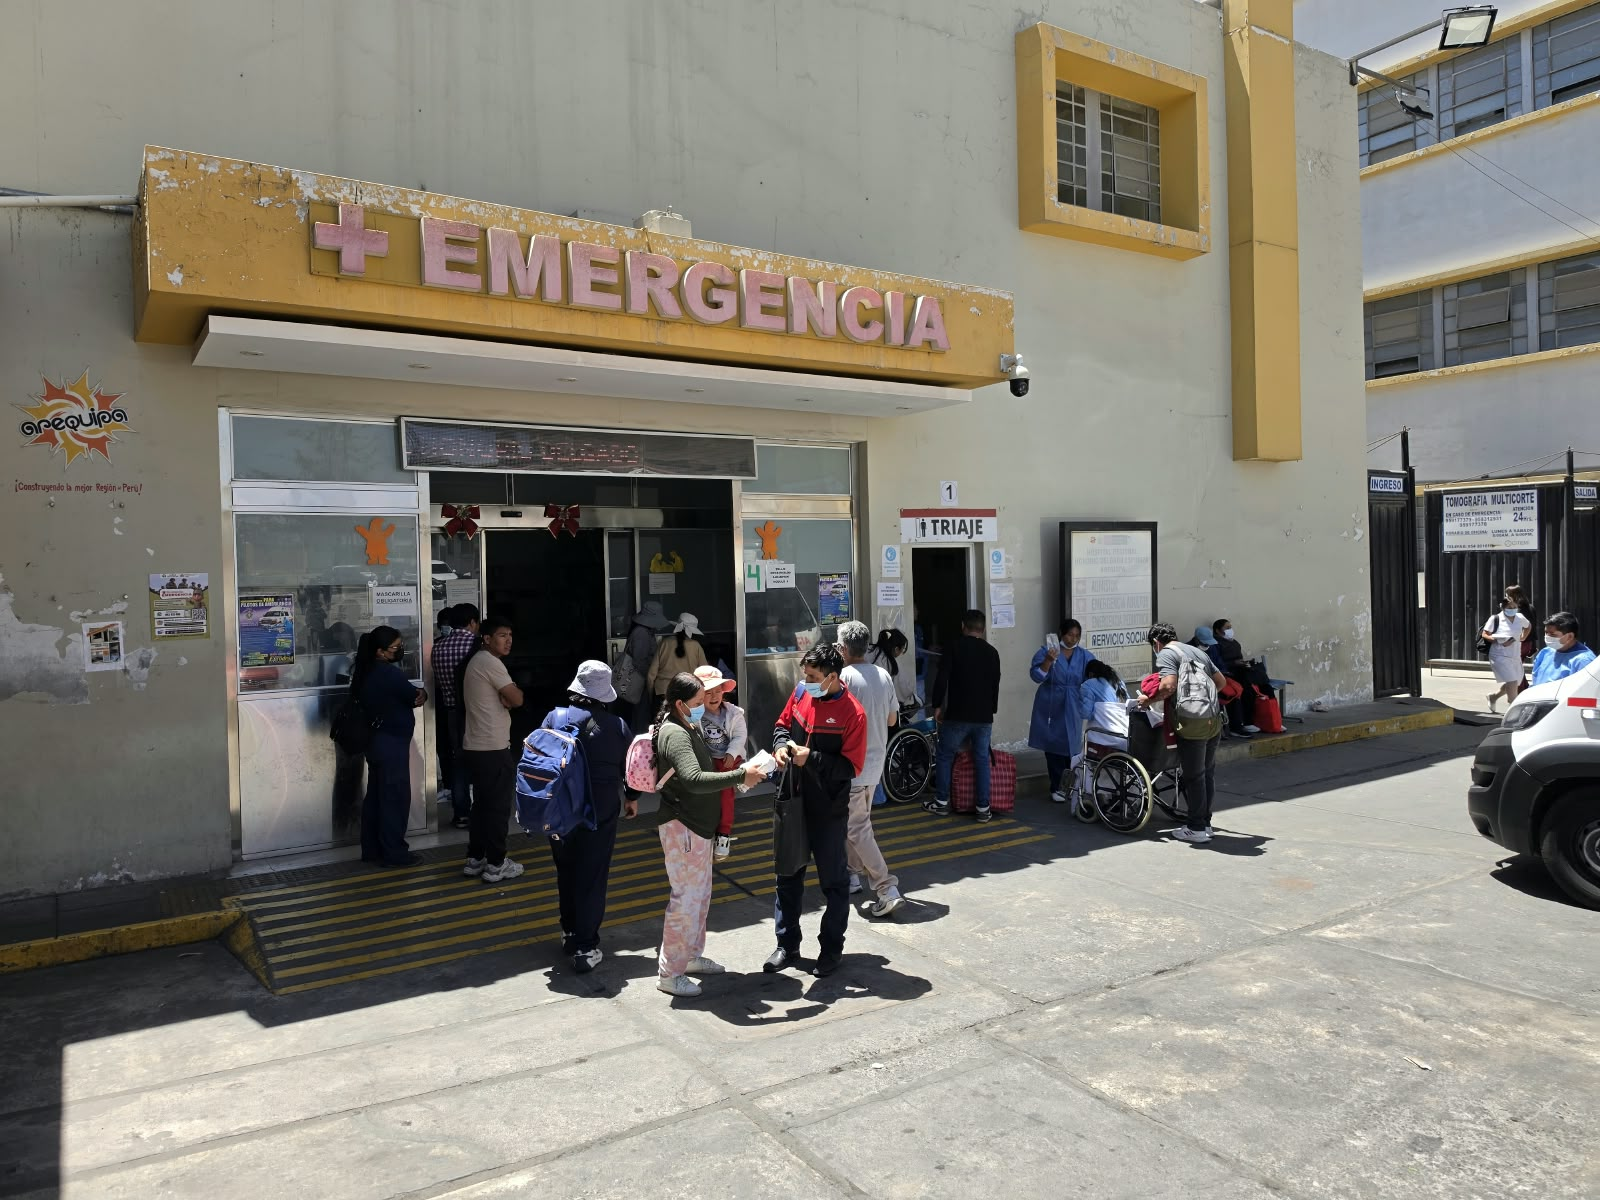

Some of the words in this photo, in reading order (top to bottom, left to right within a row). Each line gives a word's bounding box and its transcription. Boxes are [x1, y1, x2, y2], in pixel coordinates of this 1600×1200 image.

[420, 215, 951, 351] EMERGENCIA
[66, 483, 72, 491] la
[74, 482, 93, 493] mejor
[1371, 478, 1402, 490] INGRESO
[946, 485, 952, 499] 1
[1575, 488, 1596, 497] SALIDA
[1445, 495, 1488, 508] TOMOGRAFIA
[1491, 492, 1535, 506] MULTICORTE
[931, 519, 983, 540] TRIAJE
[747, 564, 761, 591] 4
